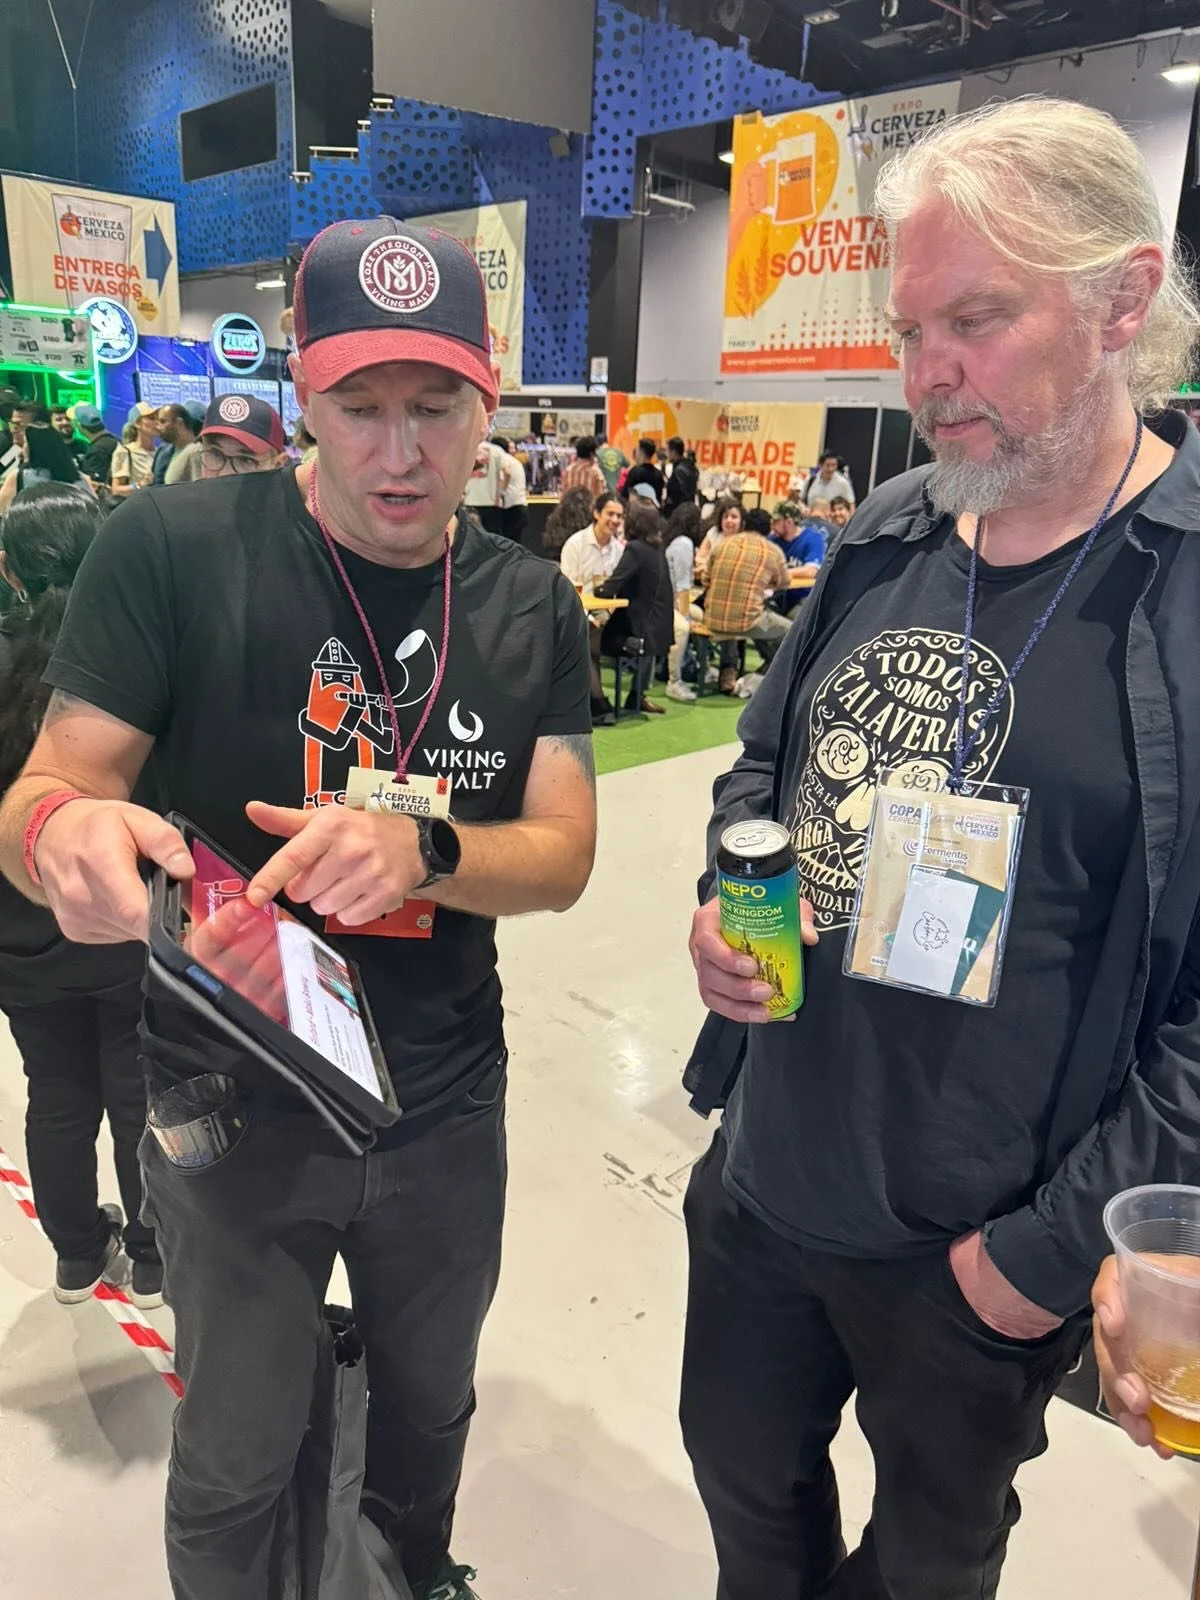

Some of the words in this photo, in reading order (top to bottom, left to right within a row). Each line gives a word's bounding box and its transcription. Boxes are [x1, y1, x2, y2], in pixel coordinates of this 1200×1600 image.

[892, 100, 923, 113] EXPO
[871, 108, 946, 134] CERVEZA
[76, 216, 124, 231] CERVEZA
[800, 215, 888, 248] VENTA
[85, 227, 126, 241] MEXICO
[54, 255, 141, 280] ENTREGA
[364, 255, 376, 284] MORE
[373, 241, 424, 259] THROUGH
[423, 261, 435, 287] MALT
[54, 274, 79, 292] DE
[82, 277, 144, 302] VASOS
[371, 288, 406, 308] VIKING
[409, 290, 430, 308] MALT
[687, 439, 757, 466] VENTA
[762, 441, 796, 466] DE
[876, 650, 985, 704] TODOS
[884, 676, 952, 712] SOMOS
[834, 661, 986, 752] CALAVERAS
[423, 749, 507, 769] VIKING
[385, 792, 431, 806] CERVEZA
[391, 801, 431, 814] MEXICO
[823, 793, 839, 810] LA
[889, 804, 921, 819] COPA
[795, 820, 834, 850] ARGA
[965, 821, 999, 832] CERVEZA
[970, 828, 999, 838] MEXICO
[922, 846, 969, 860] Fermentis
[722, 877, 767, 898] NEPO
[733, 905, 782, 918] KINGDOM
